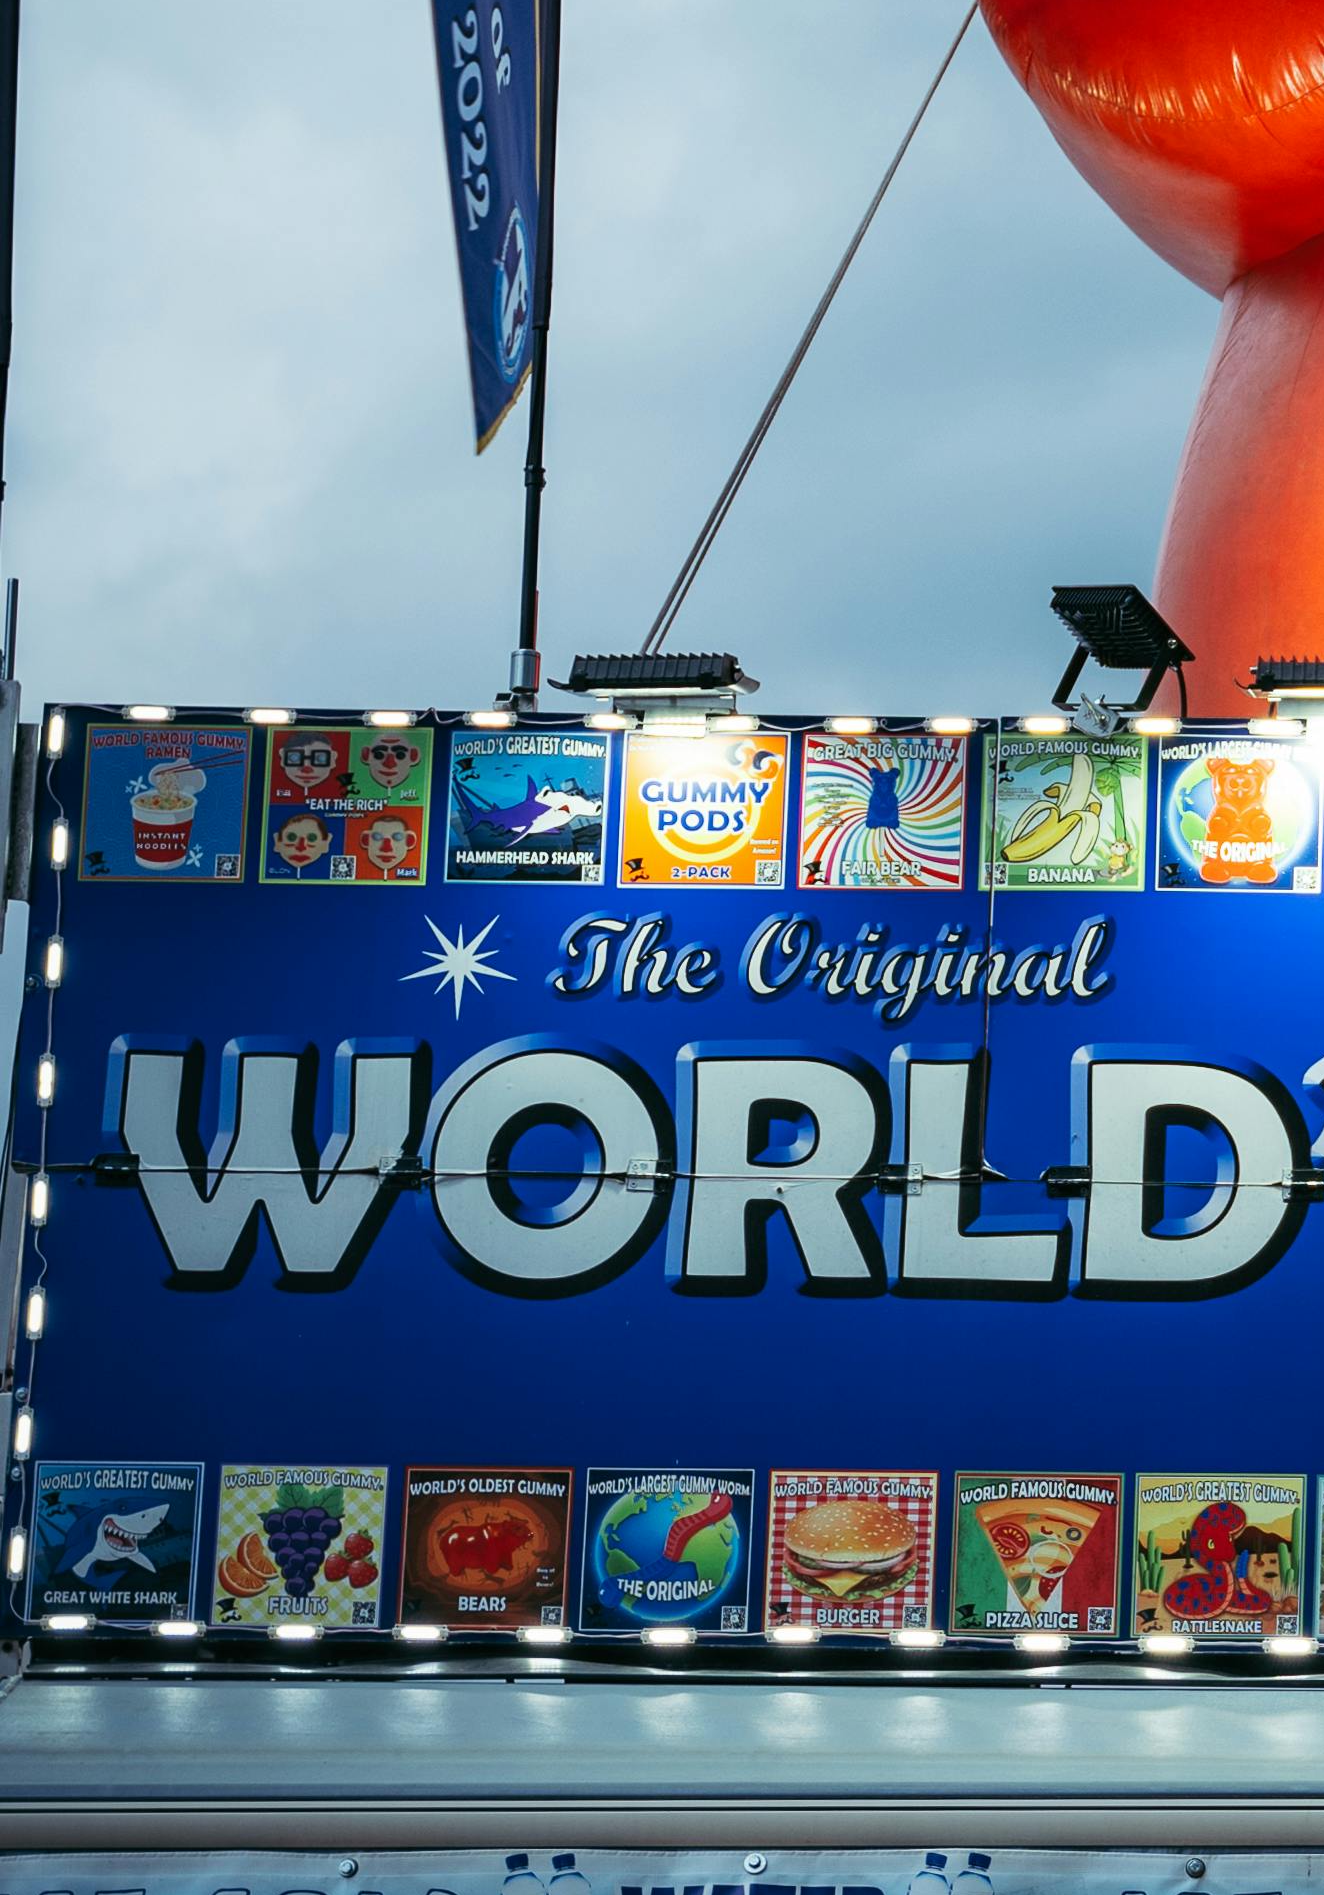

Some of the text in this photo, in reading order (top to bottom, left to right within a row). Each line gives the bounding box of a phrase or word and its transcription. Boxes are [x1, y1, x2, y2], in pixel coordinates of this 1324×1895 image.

[452, 9, 491, 233] 2022
[455, 849, 594, 867] HAMMERHEAD SHARK
[1027, 867, 1097, 884] BANANA
[556, 912, 1104, 1023] The Original
[267, 1595, 328, 1616] FRUITS
[457, 1595, 507, 1612] BEARS
[816, 1607, 880, 1625] BURGER
[1171, 1619, 1263, 1635] RATTLESNAKE
